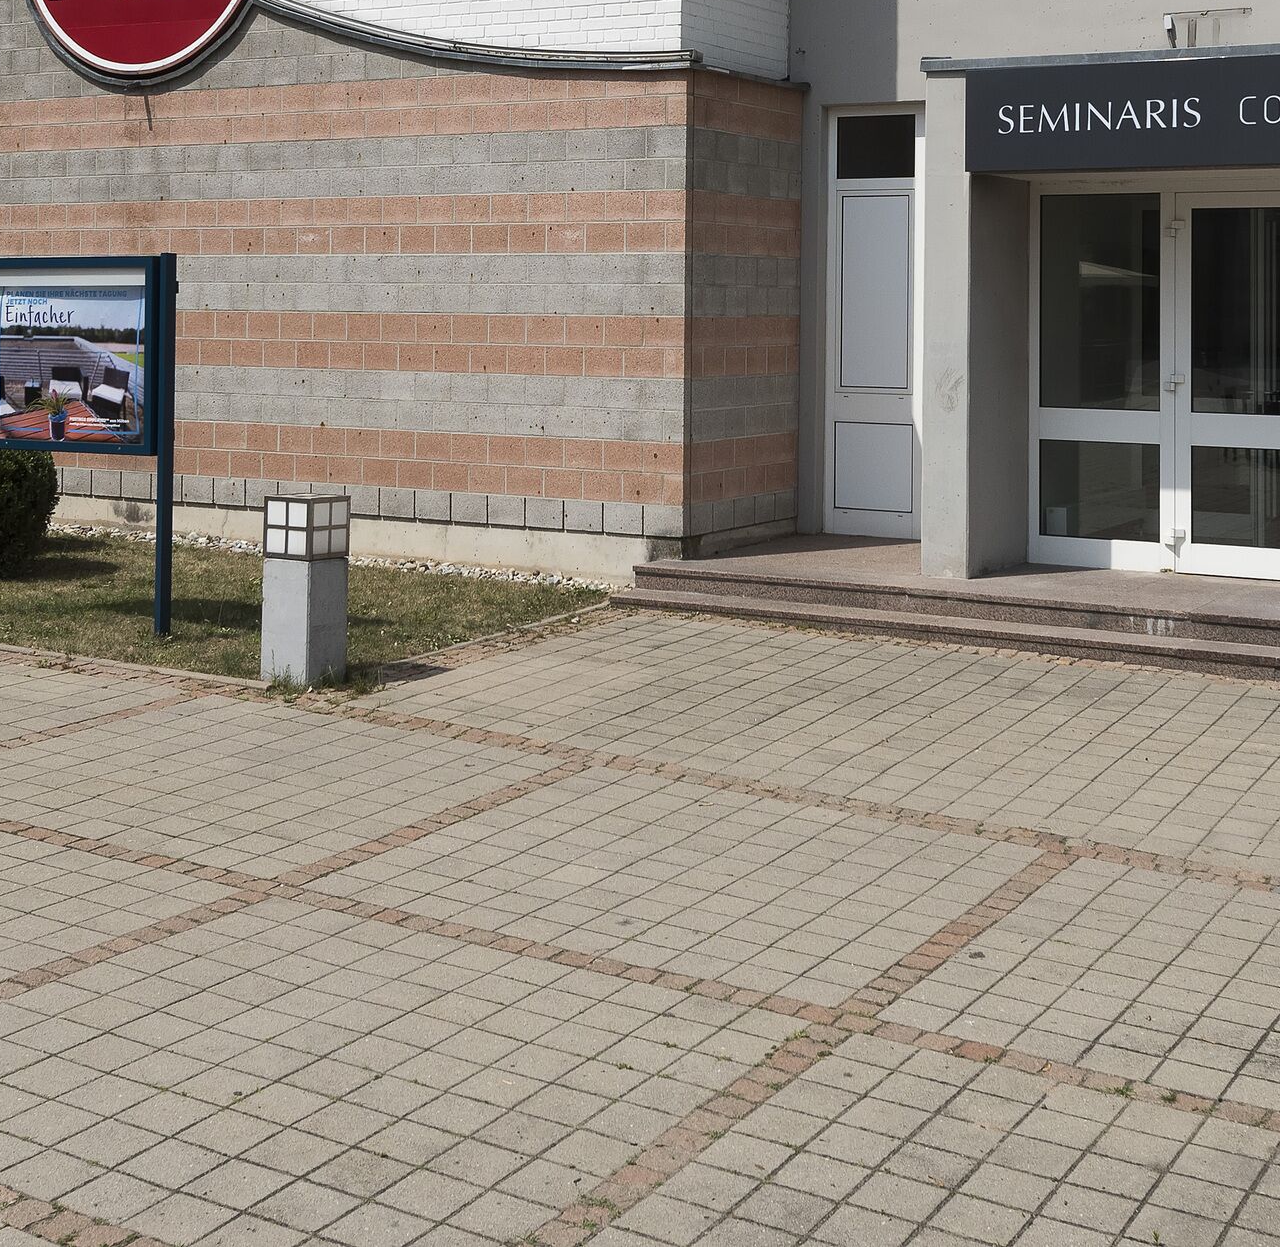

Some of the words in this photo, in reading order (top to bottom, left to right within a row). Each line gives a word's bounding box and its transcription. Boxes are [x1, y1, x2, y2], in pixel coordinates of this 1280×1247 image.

[997, 97, 1202, 134] SEMINARIS
[6, 290, 34, 298] PLANEN
[35, 290, 47, 298] SIE
[48, 290, 64, 298] IHRE
[64, 289, 97, 298] NÄCHSTE
[98, 290, 127, 298] TAGUNG
[5, 305, 74, 327] Einfacher
